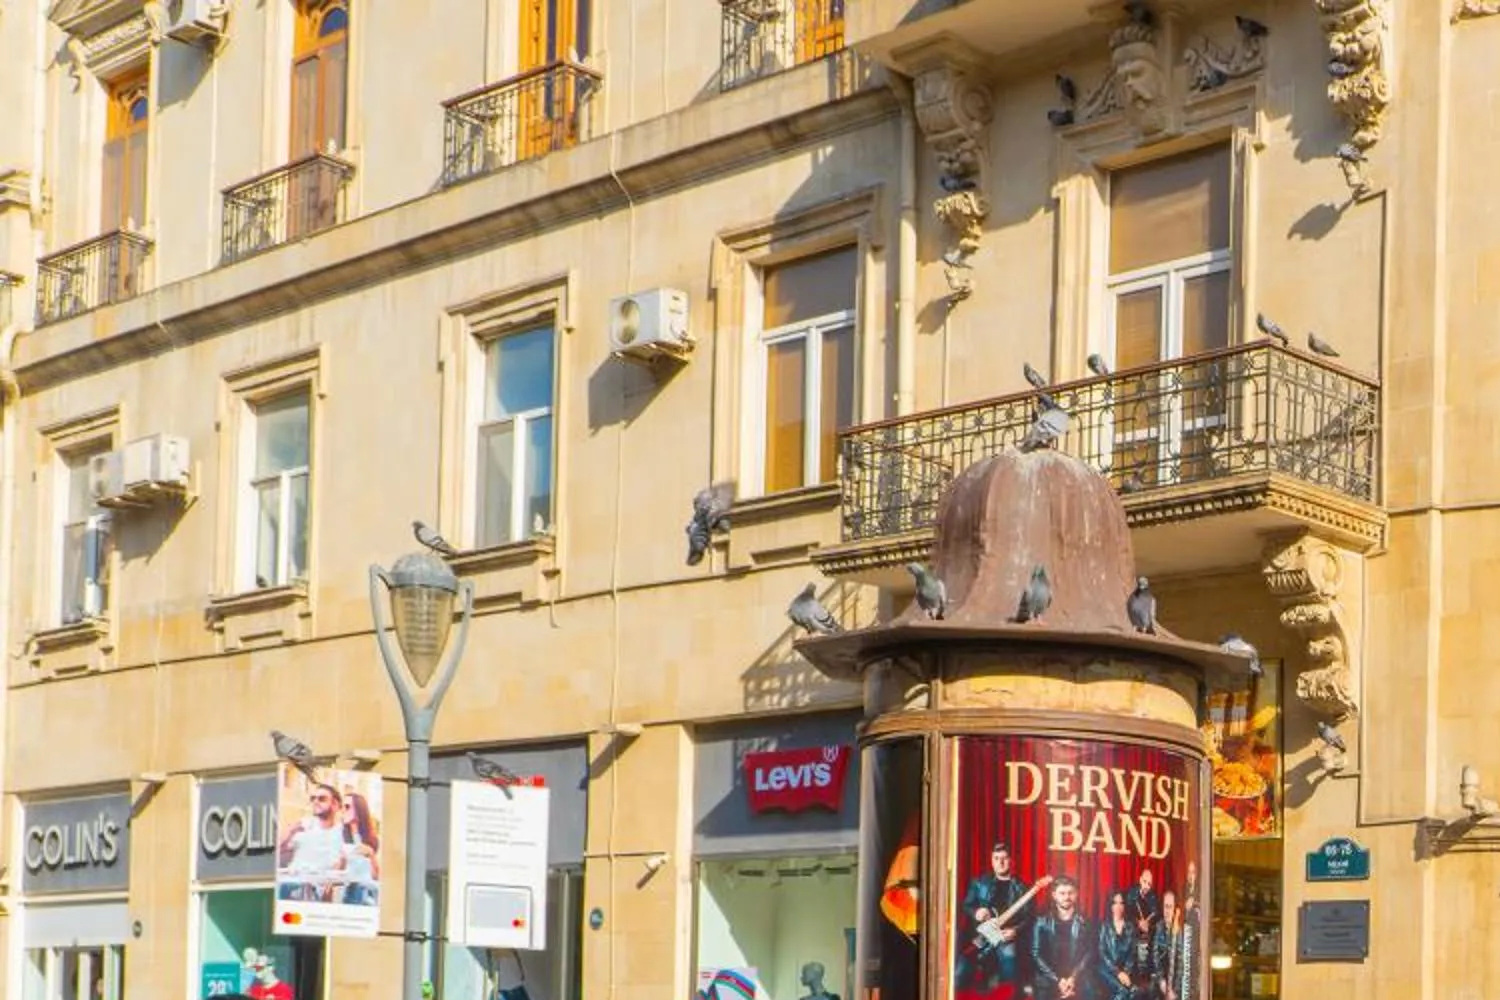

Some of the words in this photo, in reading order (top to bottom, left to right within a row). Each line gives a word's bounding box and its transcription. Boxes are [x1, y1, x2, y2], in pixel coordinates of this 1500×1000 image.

[1005, 761, 1189, 821] DERVISH
[24, 812, 119, 871] COLIN'S
[1048, 807, 1171, 859] BAND
